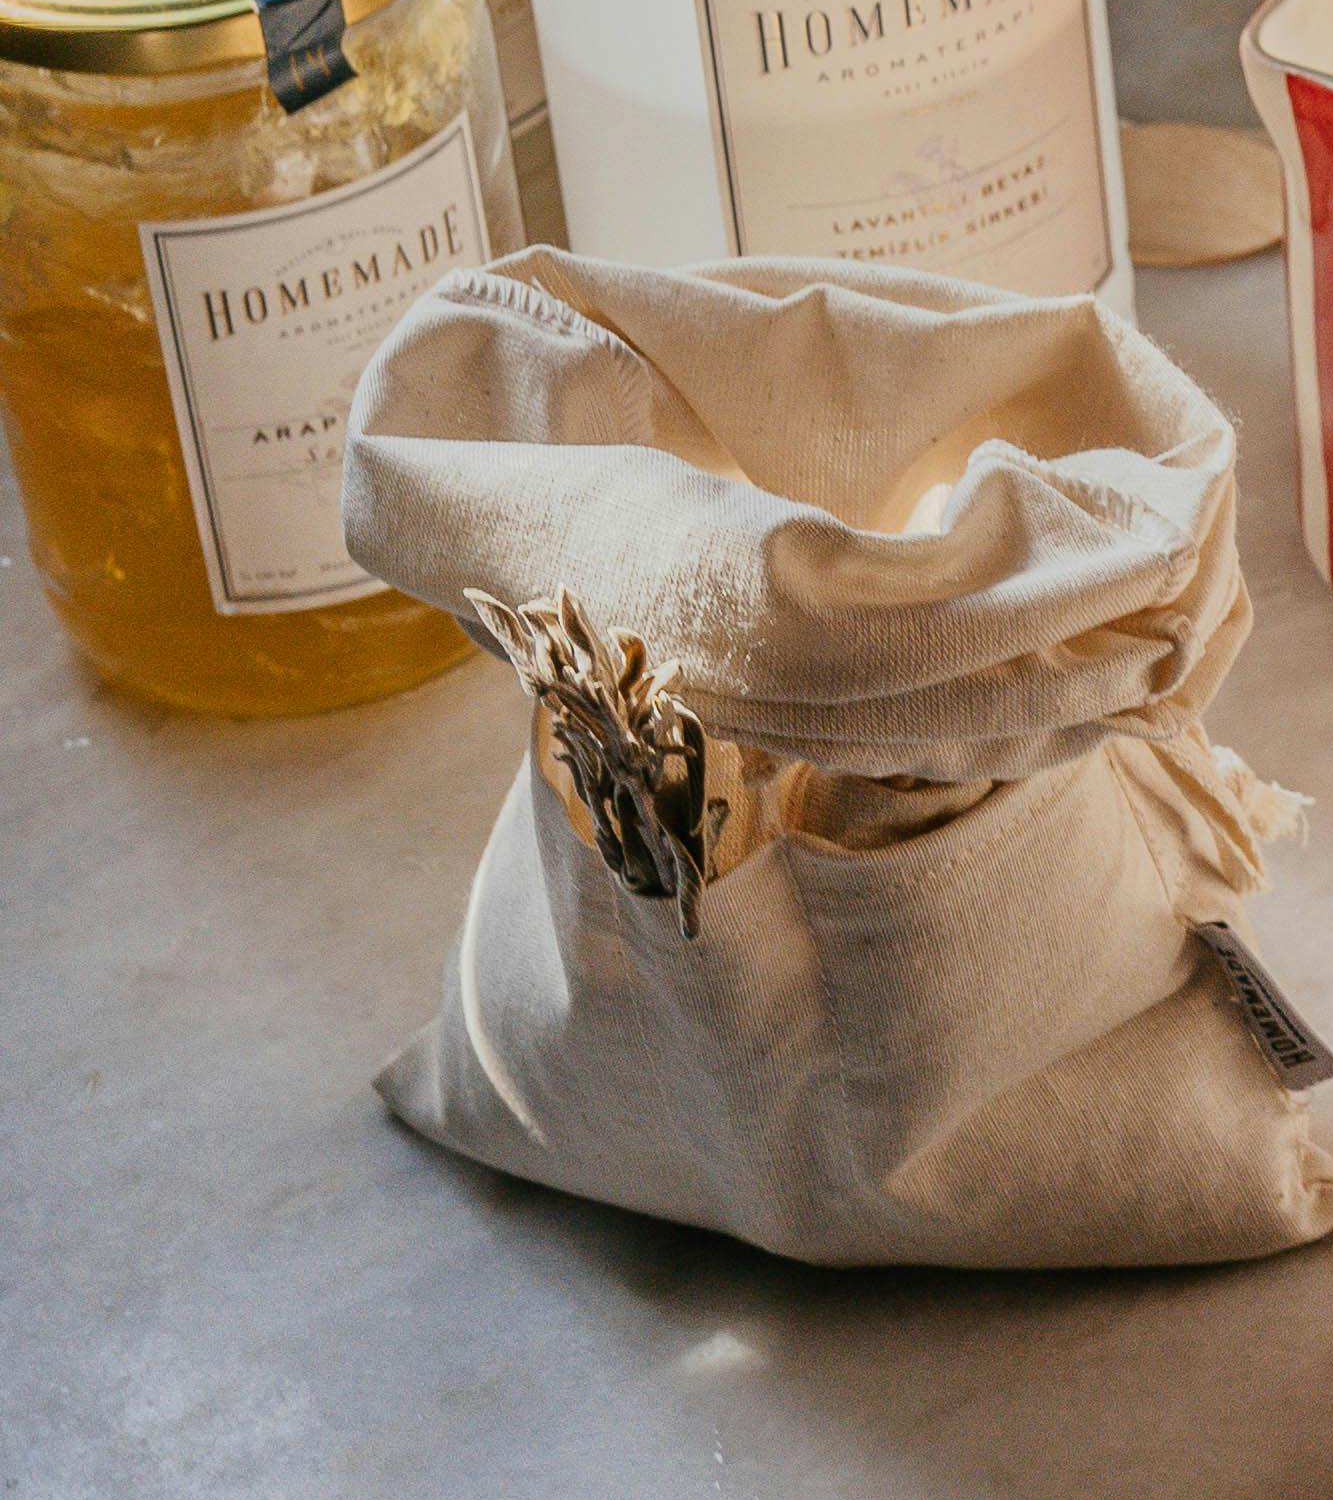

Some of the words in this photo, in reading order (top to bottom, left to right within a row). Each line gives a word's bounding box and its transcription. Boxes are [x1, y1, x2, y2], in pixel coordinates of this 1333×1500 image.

[203, 203, 464, 342] HOMEMADE
[253, 415, 337, 445] ARAP
[1216, 946, 1316, 1070] HOMEMADE
